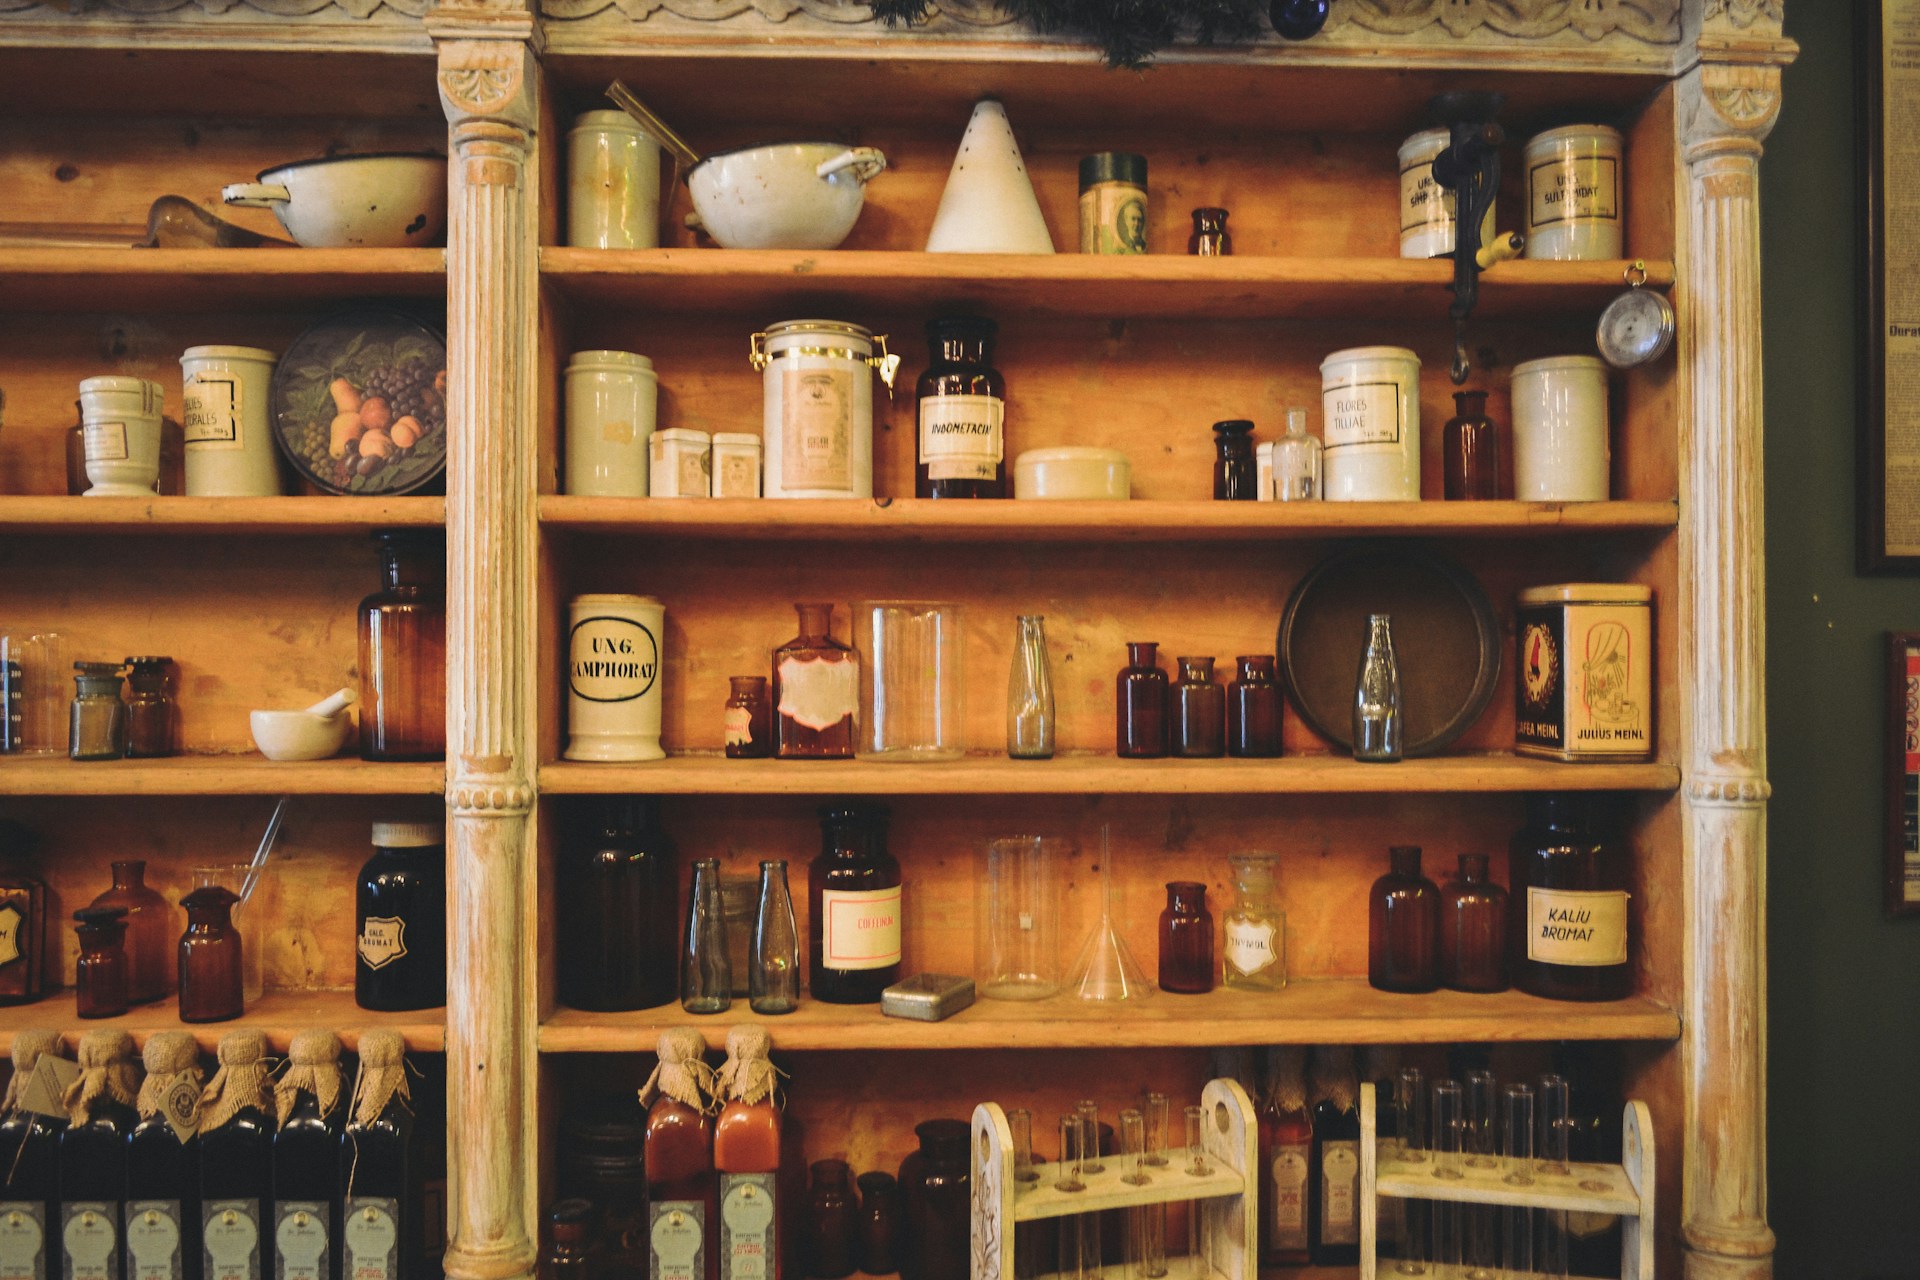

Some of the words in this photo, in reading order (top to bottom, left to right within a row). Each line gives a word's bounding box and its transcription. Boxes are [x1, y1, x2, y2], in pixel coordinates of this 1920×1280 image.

[1336, 399, 1367, 413] FLORES
[931, 422, 992, 435] INDOMETACIN
[1537, 722, 1560, 740] MEINL
[1577, 729, 1612, 740] JULIUS
[1614, 729, 1645, 740] MEINL
[1541, 926, 1595, 942] BROMAT
